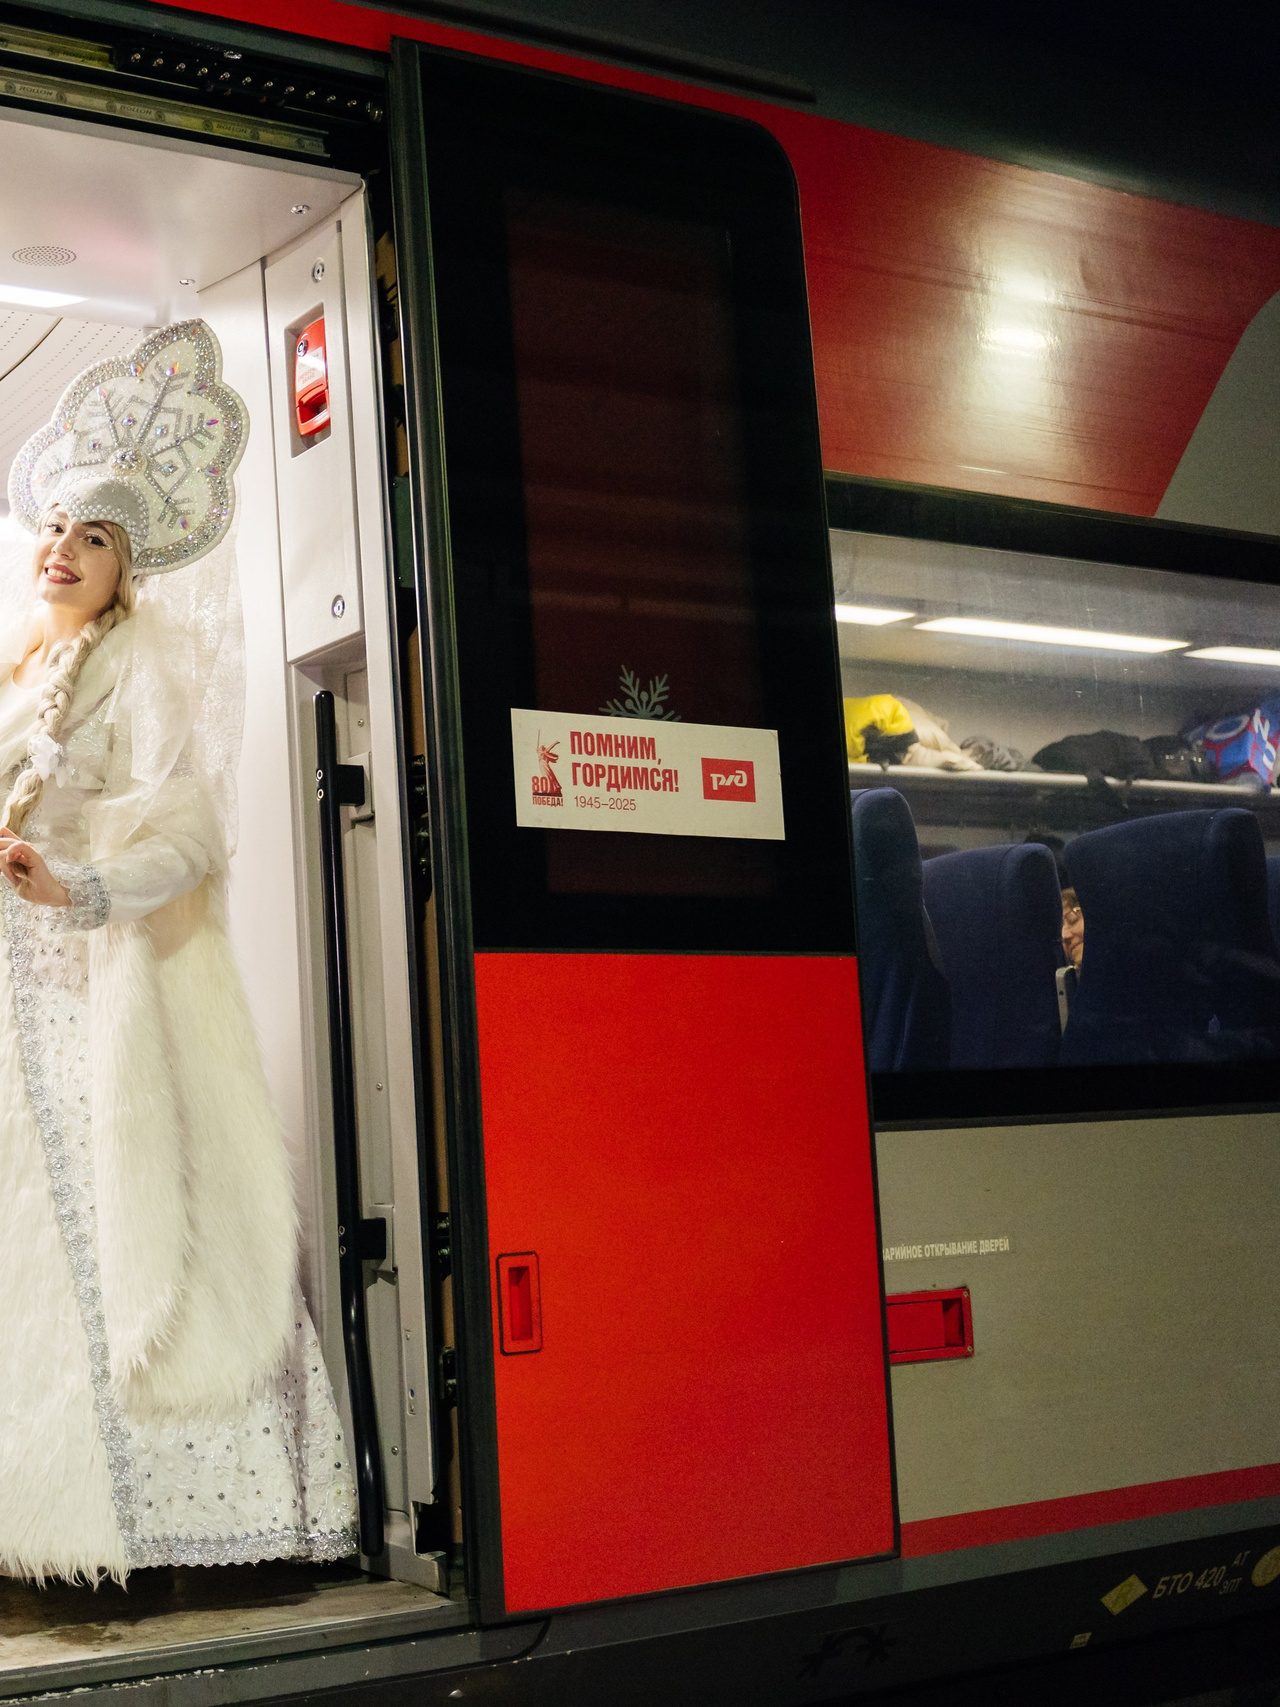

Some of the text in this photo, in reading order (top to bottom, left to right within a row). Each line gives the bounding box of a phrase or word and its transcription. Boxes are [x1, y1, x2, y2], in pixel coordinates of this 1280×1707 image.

[570, 731, 662, 765] ПОМНИМ,
[531, 775, 549, 793] 80
[572, 762, 679, 793] ГОРДИМСЯ!
[532, 796, 564, 807] ПОБЕДА!
[883, 1236, 1010, 1260] АРИЙНОЕ ОТКРЫВАНИЕ ДВЕРЕЙ
[1152, 1570, 1194, 1599] БТО
[1194, 1565, 1227, 1590] 420
